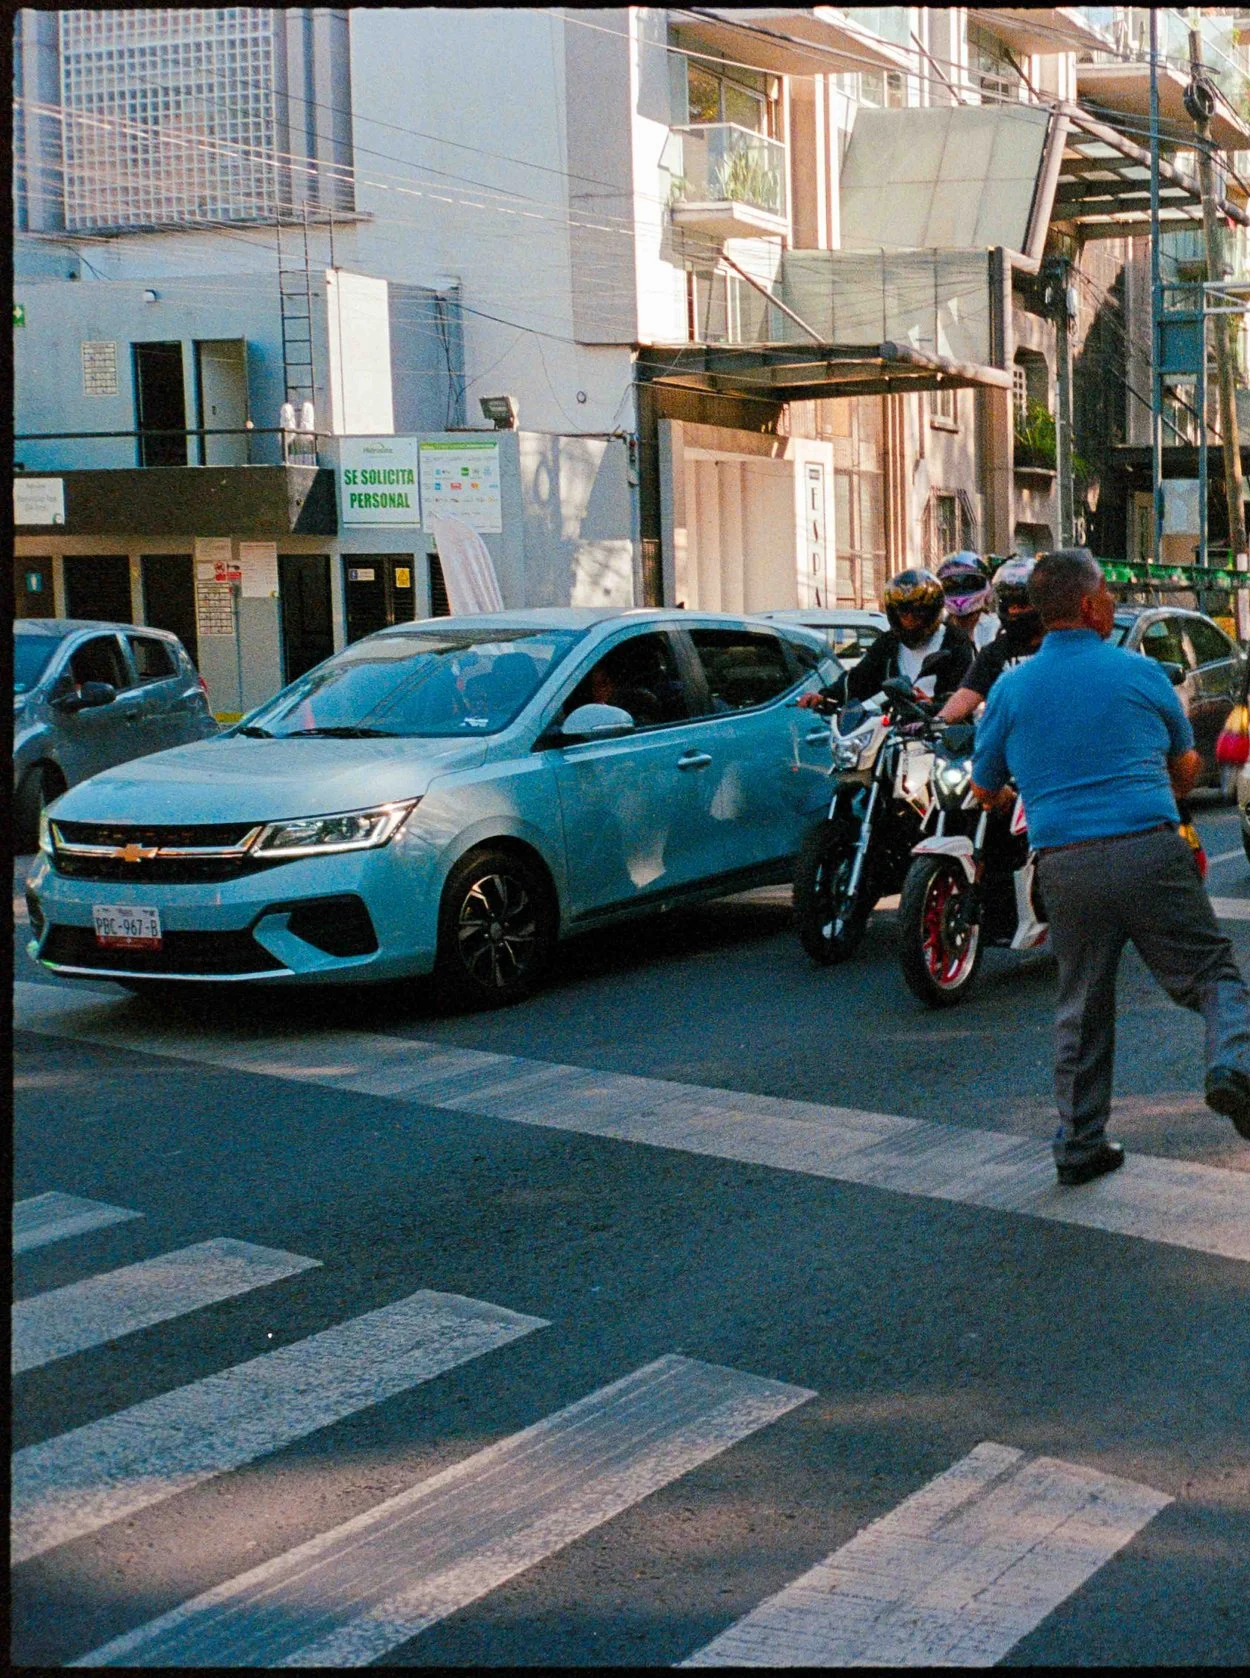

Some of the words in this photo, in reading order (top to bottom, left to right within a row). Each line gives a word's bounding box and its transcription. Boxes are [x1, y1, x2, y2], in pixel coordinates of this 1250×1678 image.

[344, 469, 358, 485] SE
[361, 469, 415, 485] SOLICITA
[350, 493, 410, 508] PERSONAL
[96, 917, 158, 937] PBC-967-B
